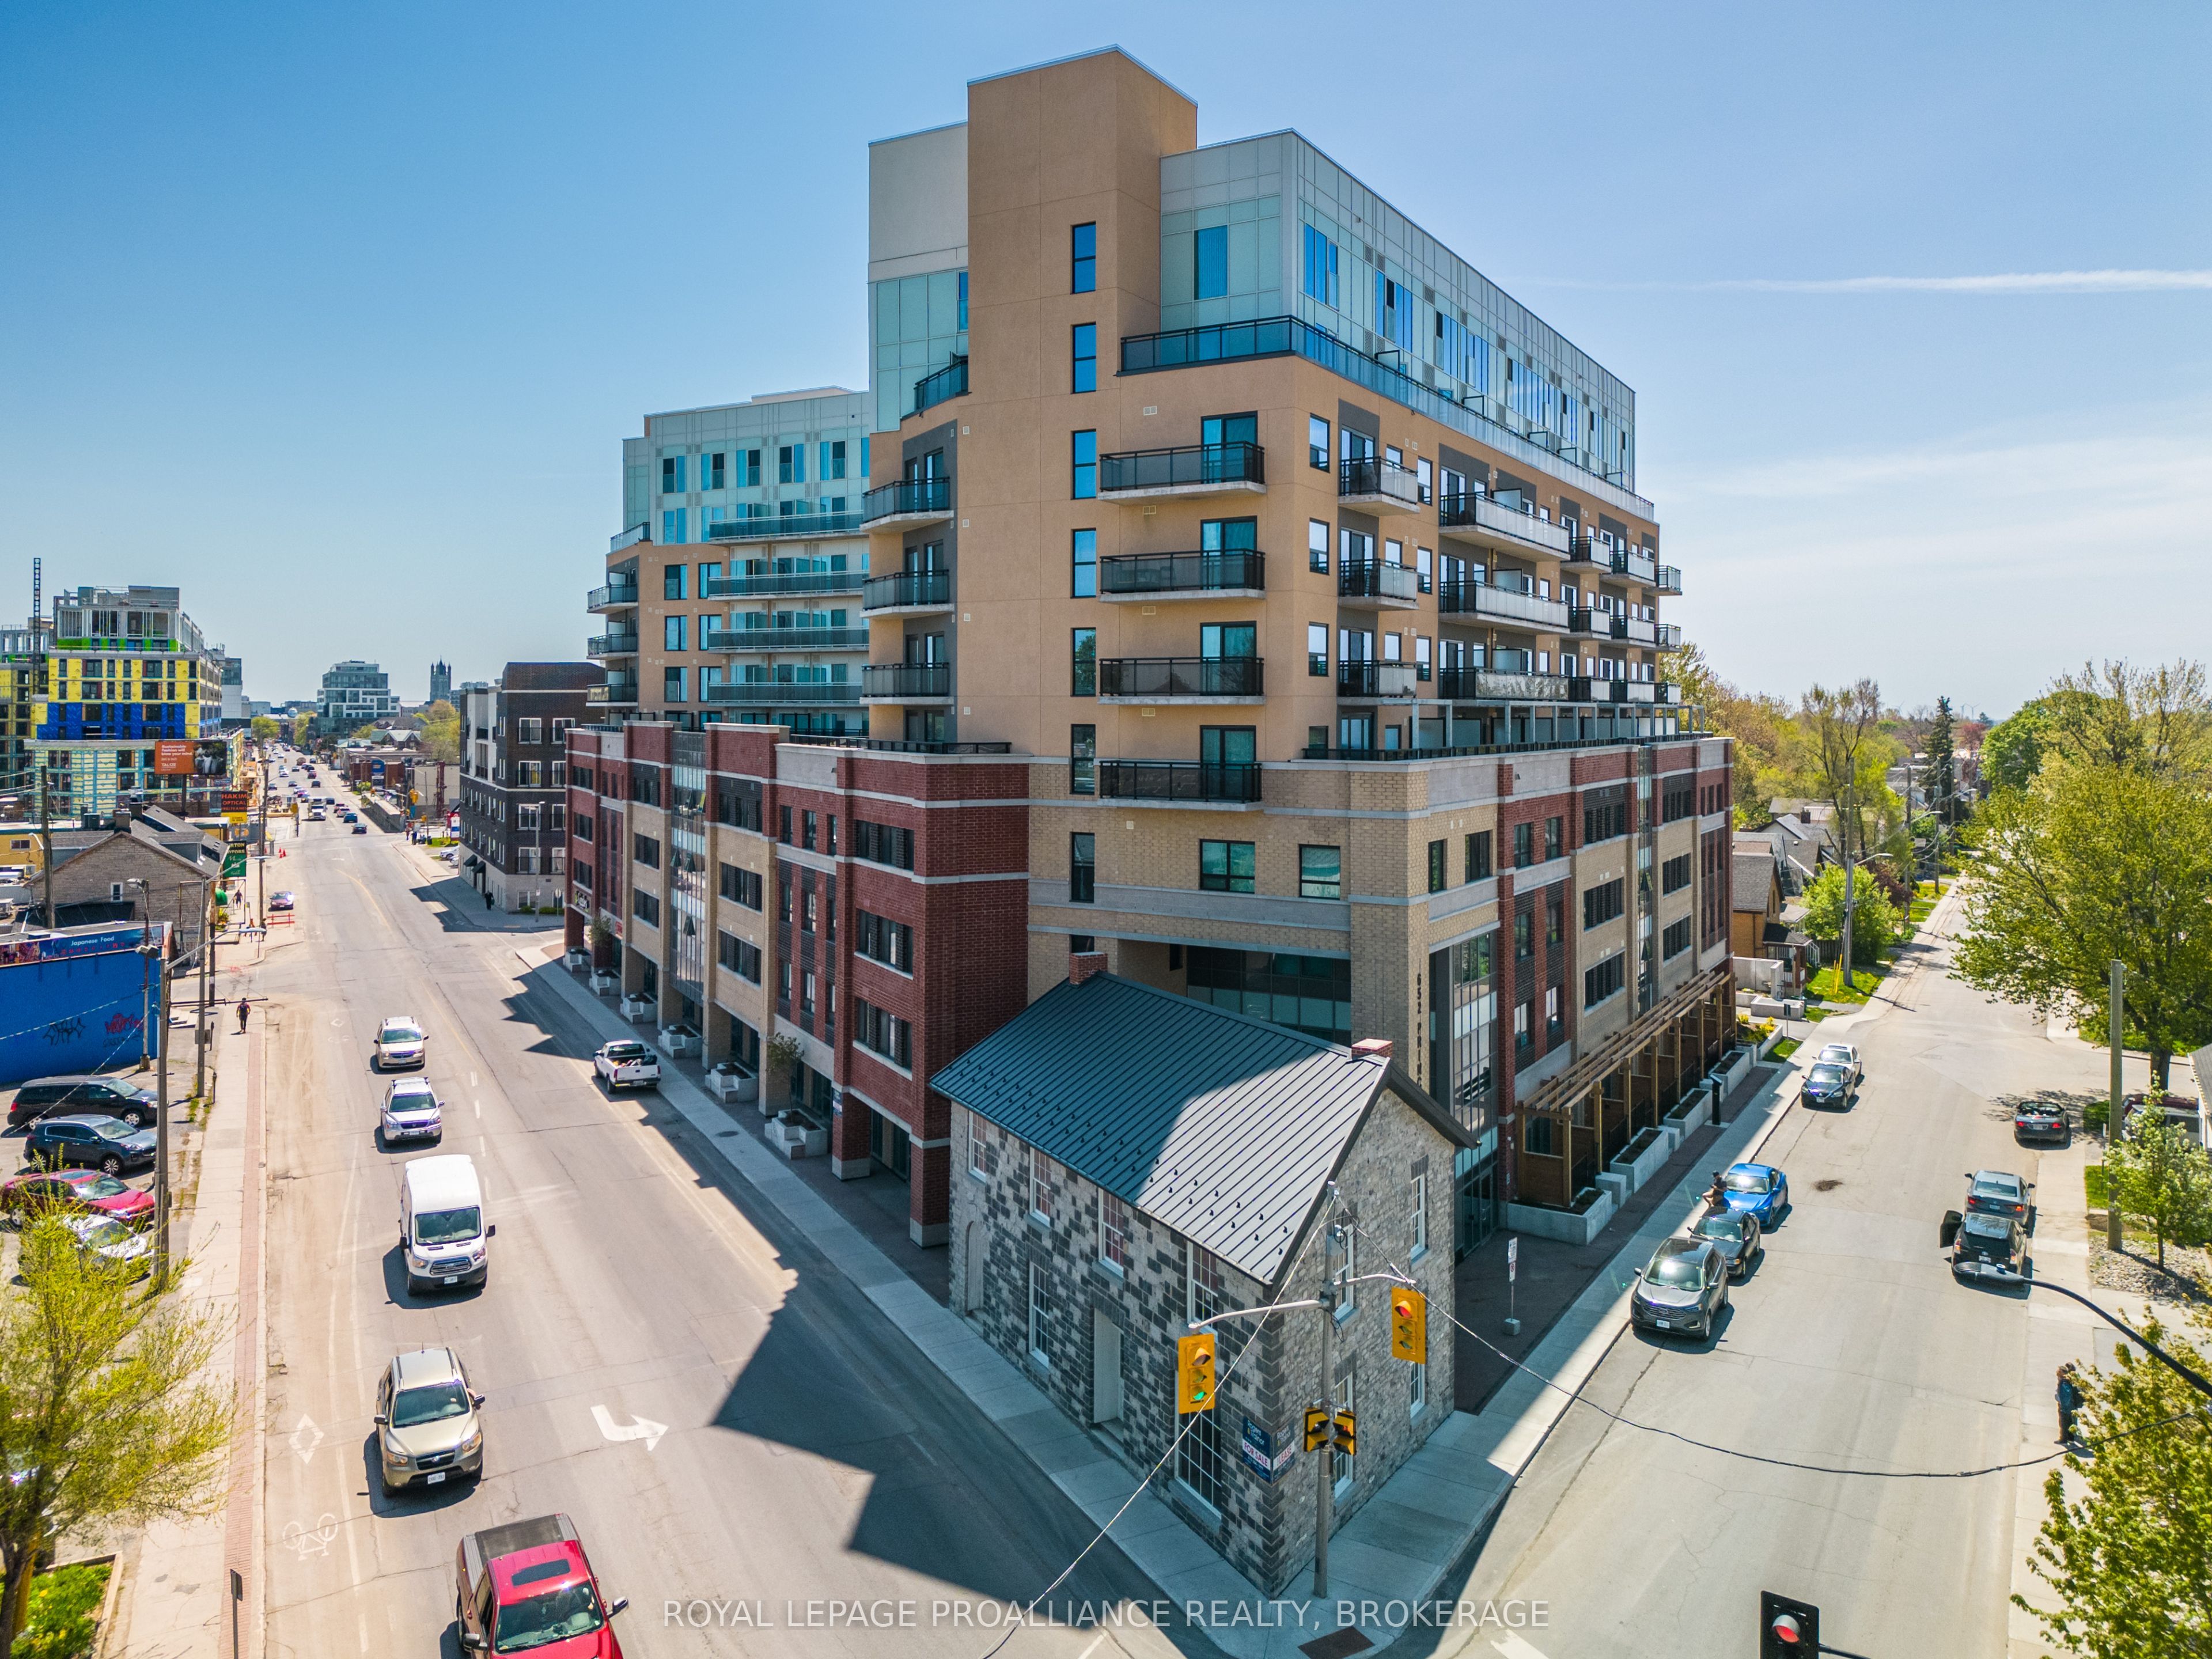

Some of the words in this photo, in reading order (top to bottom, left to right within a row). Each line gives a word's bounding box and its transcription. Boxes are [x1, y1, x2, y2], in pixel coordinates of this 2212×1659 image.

[1244, 1442, 1255, 1456] FOR
[1255, 1450, 1268, 1467] SALE
[1279, 1446, 1291, 1464] LEASE
